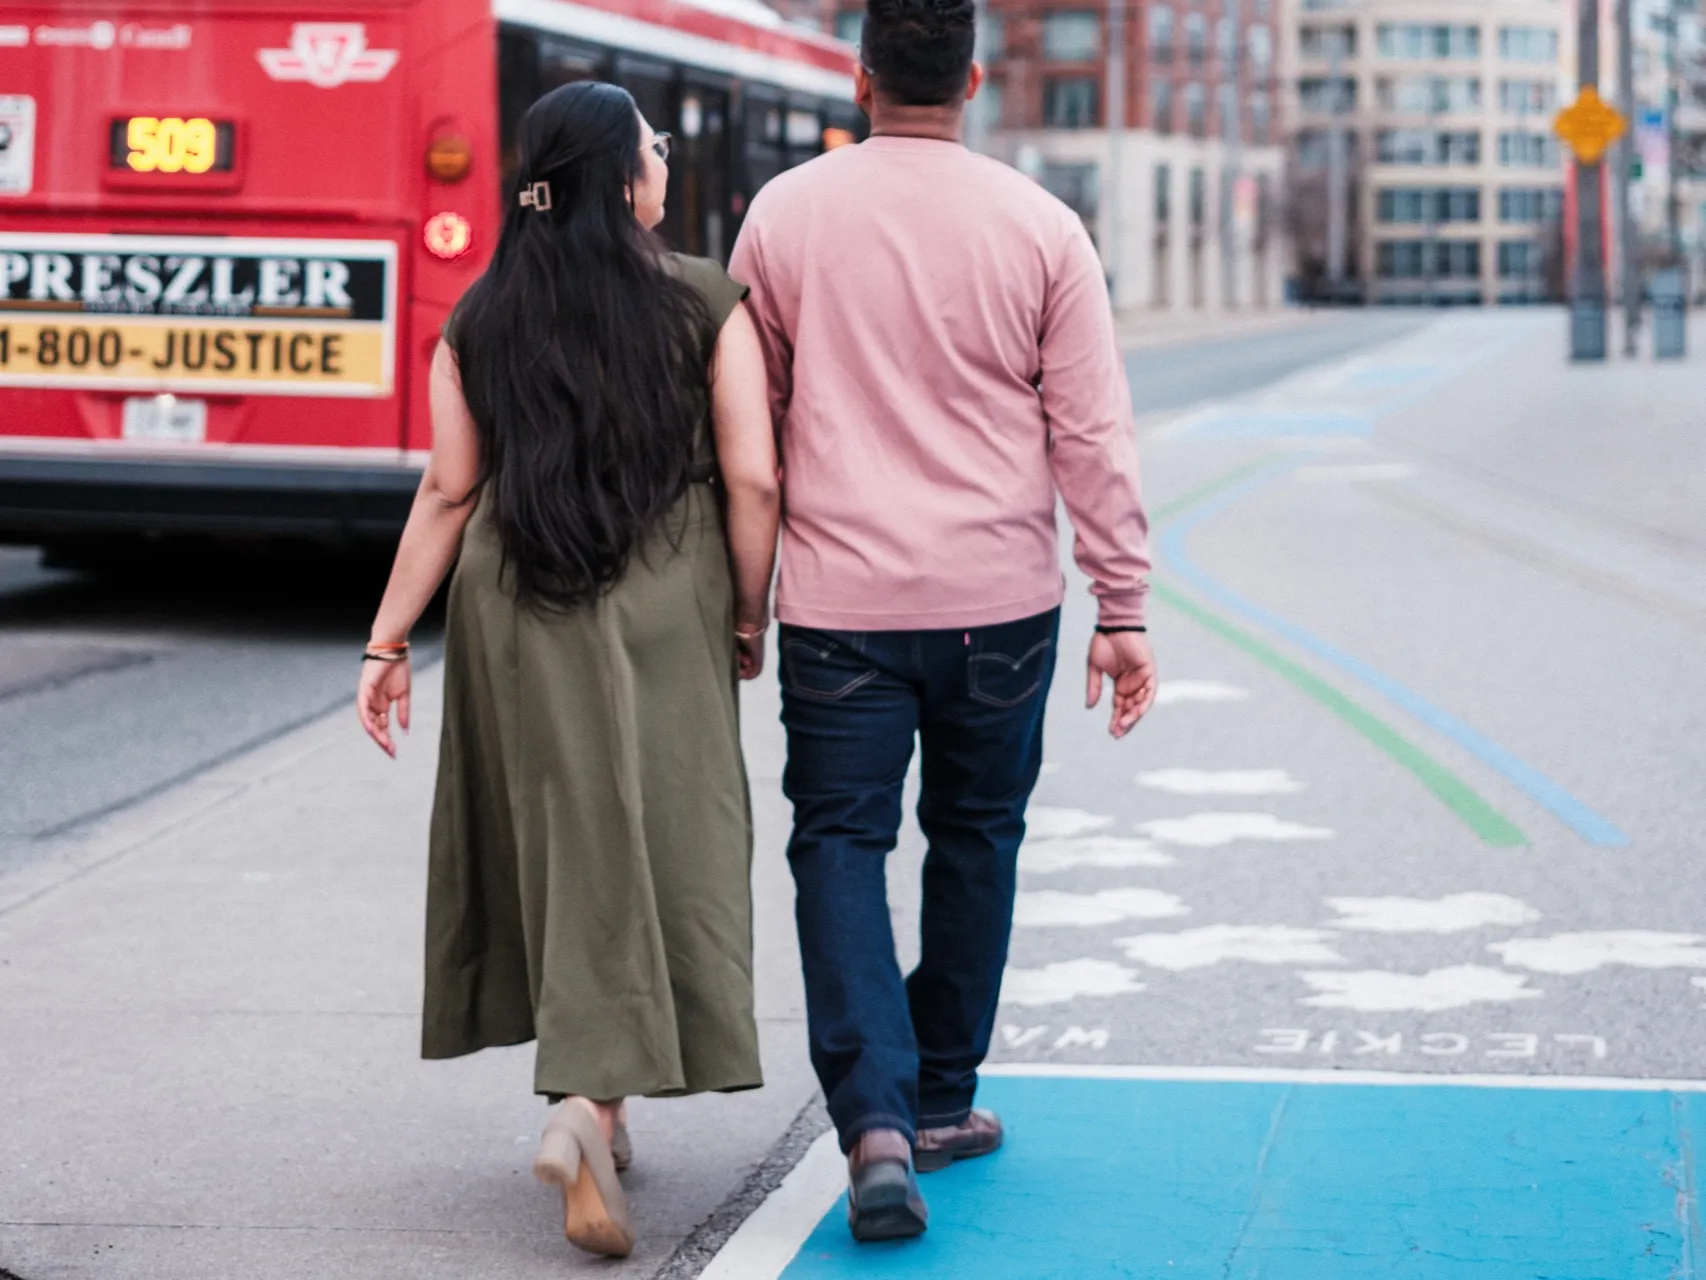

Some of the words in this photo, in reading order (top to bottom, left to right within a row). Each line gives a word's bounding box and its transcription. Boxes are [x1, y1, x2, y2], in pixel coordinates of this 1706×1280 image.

[127, 117, 216, 173] 509
[0, 253, 352, 308] PRESZLER
[0, 325, 346, 375] 1-800-JUSTICE
[1001, 1024, 1110, 1051] WA
[1254, 1027, 1607, 1058] LECKIE
